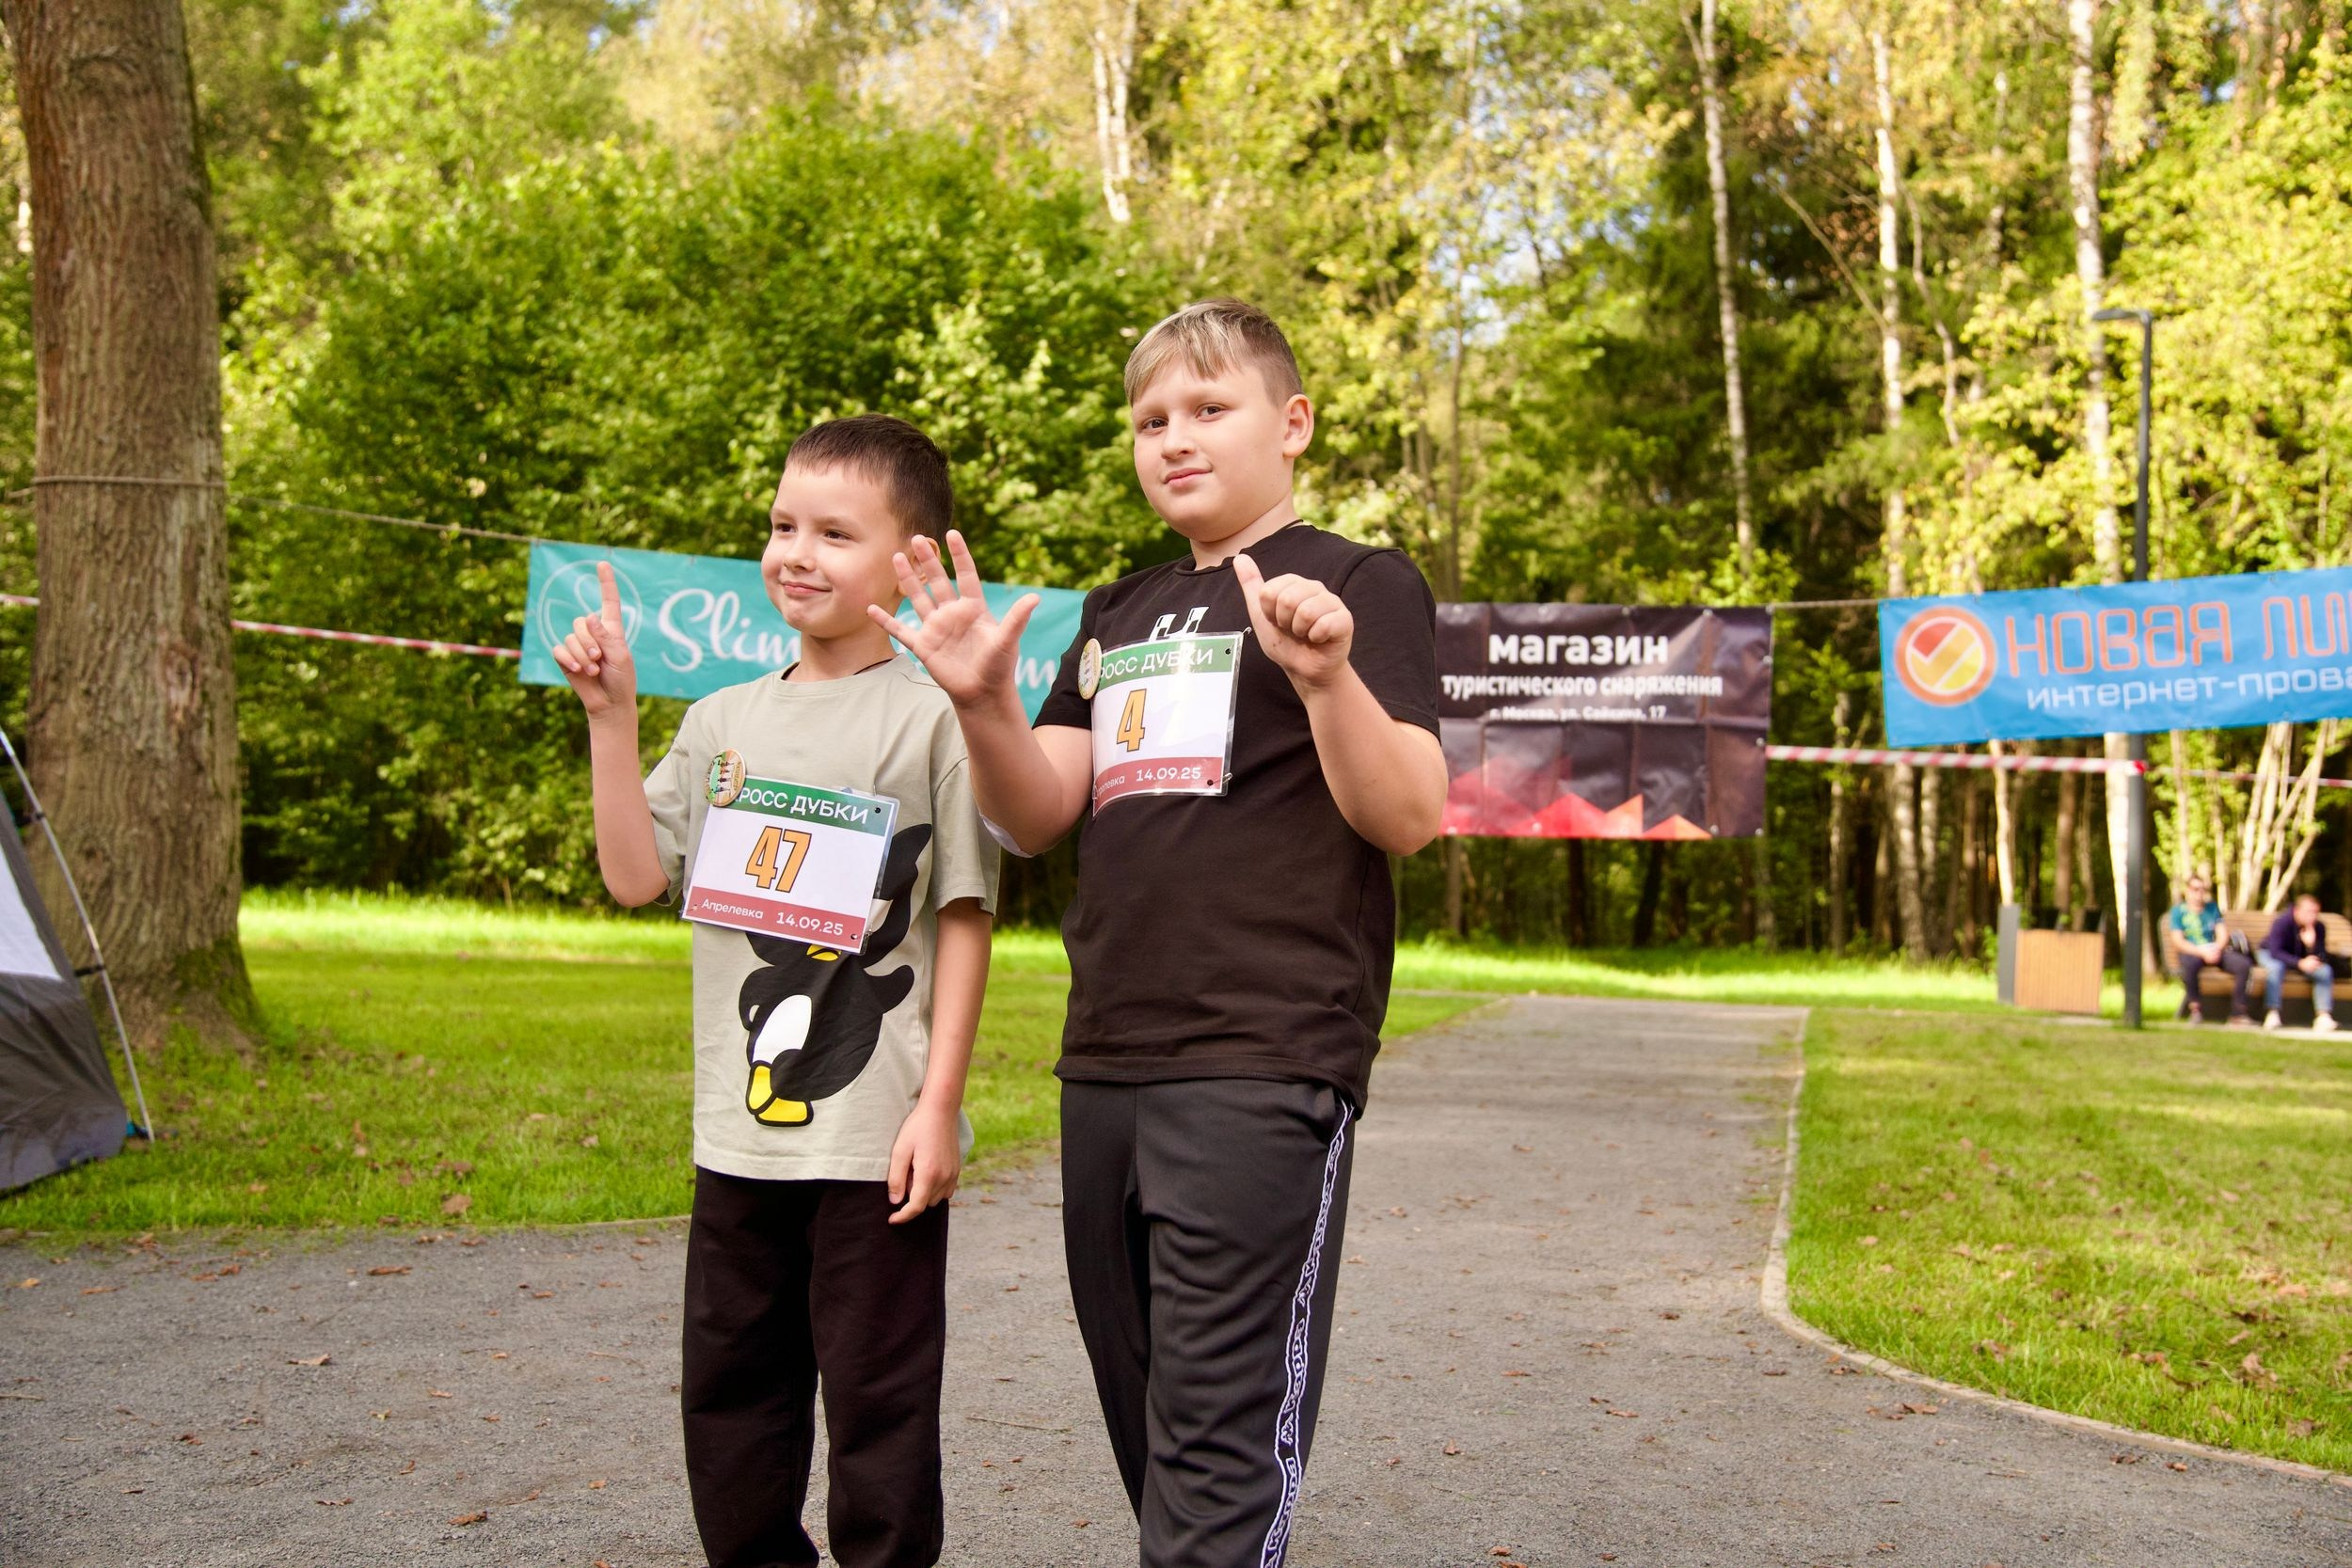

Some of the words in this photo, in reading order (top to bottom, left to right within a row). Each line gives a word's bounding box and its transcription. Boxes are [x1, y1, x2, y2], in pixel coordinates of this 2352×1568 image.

[2262, 591, 2352, 660] ЛИ
[1141, 648, 1214, 673] ДУБКИ
[1488, 634, 1669, 664] магазин
[1441, 674, 1597, 700] туристического
[1600, 674, 1723, 699] снаряжения
[2026, 666, 2352, 712] интернет-пров
[1117, 688, 1147, 752] 4
[1648, 705, 1666, 721] 17
[1136, 767, 1201, 782] 14.09.25
[735, 787, 788, 809] РОСС
[790, 795, 869, 825] ДУБКИ
[744, 825, 813, 894] 47
[701, 898, 764, 920] Апрелевка
[775, 911, 844, 936] 14.09.25
